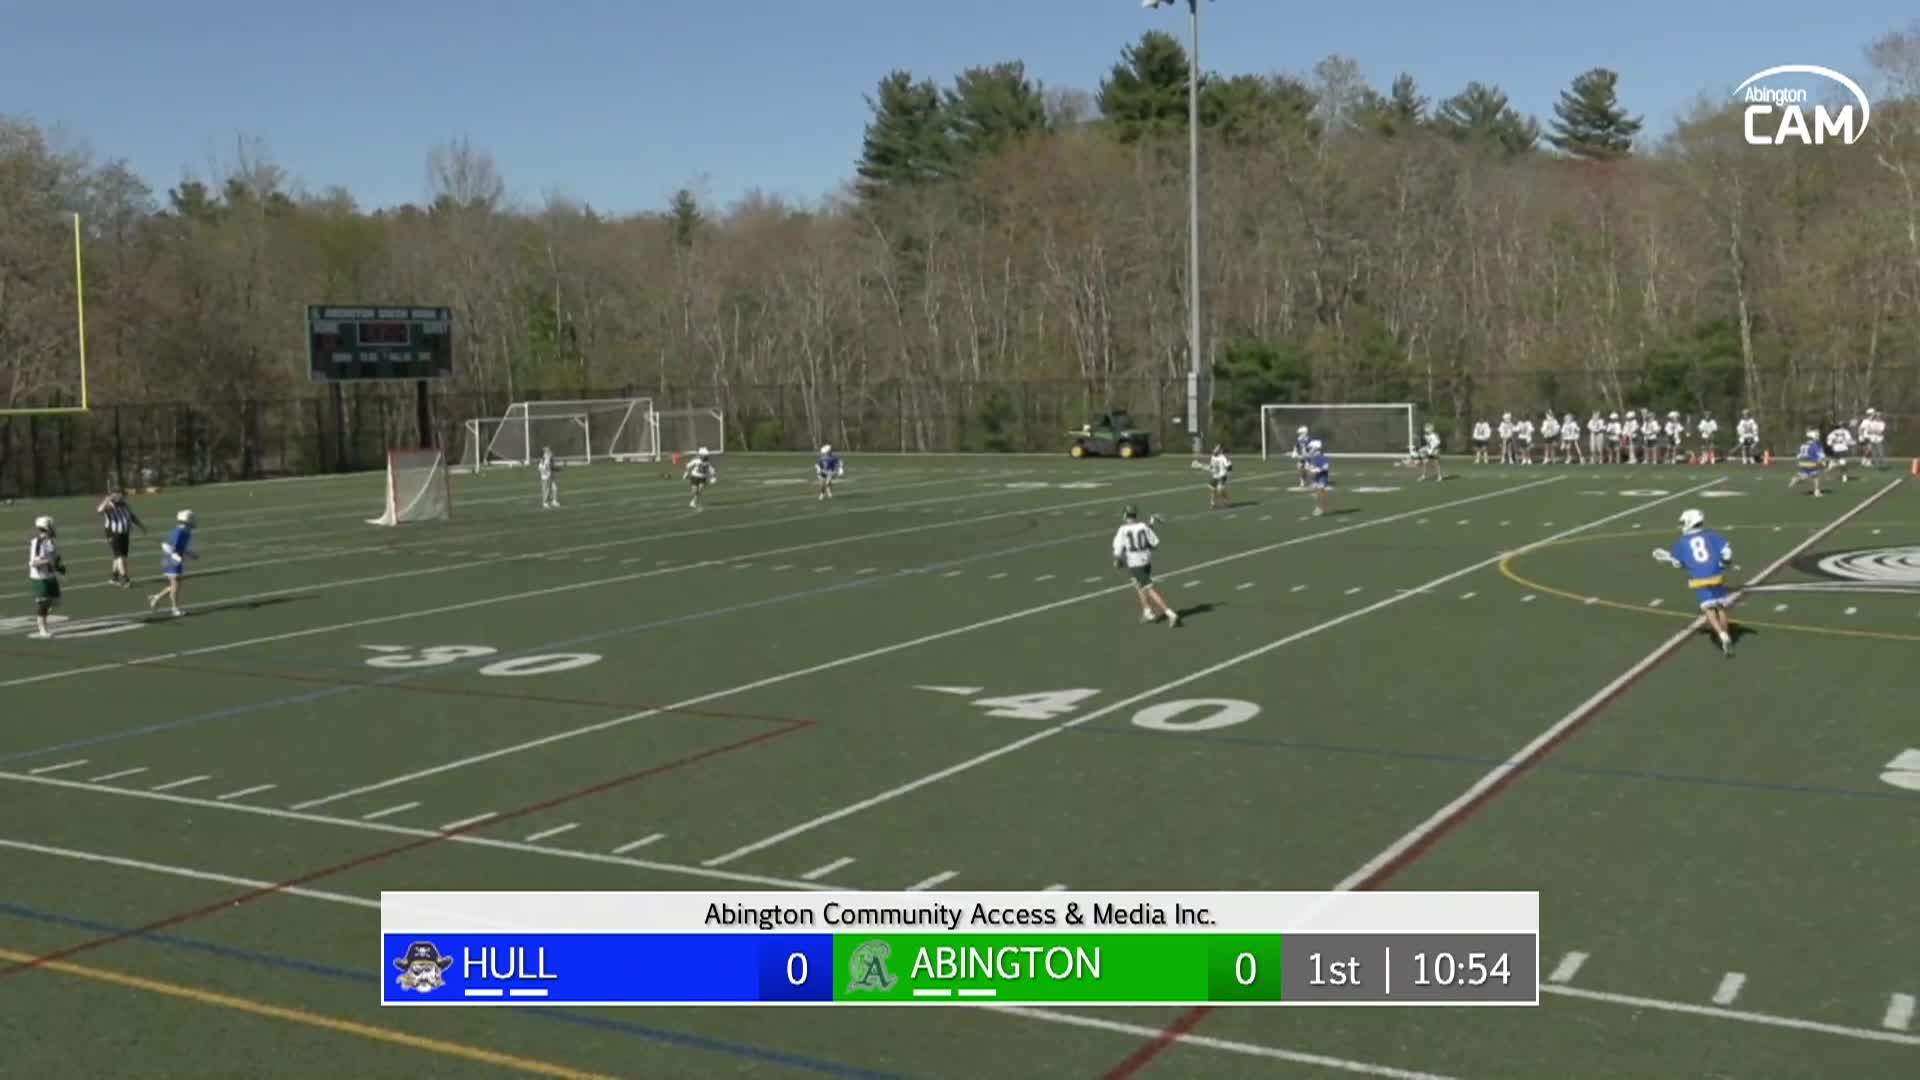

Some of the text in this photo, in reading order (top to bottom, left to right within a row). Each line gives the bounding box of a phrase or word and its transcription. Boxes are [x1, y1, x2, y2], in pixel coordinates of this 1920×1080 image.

[1127, 529, 1149, 552] 10
[1689, 535, 1710, 563] 8
[968, 687, 1262, 732] 40
